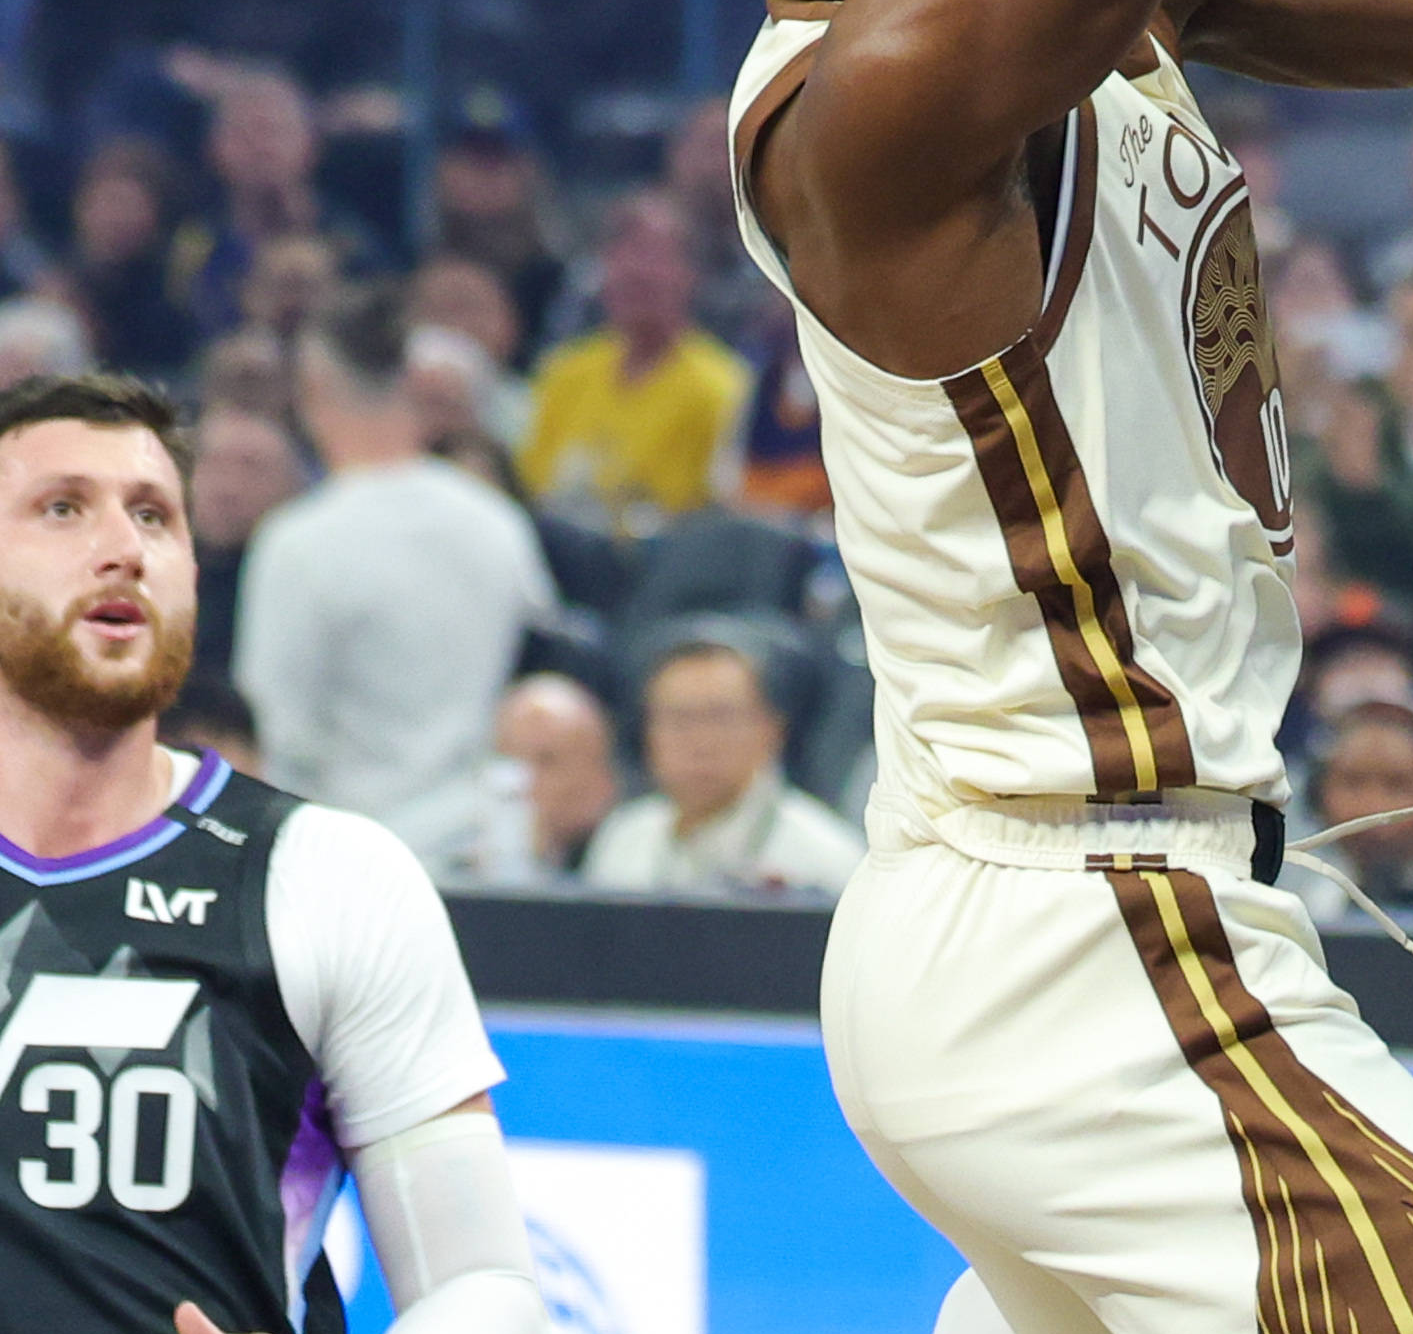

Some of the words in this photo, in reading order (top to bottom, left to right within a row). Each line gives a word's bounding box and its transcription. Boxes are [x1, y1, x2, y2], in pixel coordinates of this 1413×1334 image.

[1119, 114, 1153, 188] The
[124, 876, 219, 926] LVT
[18, 1060, 198, 1213] 30
